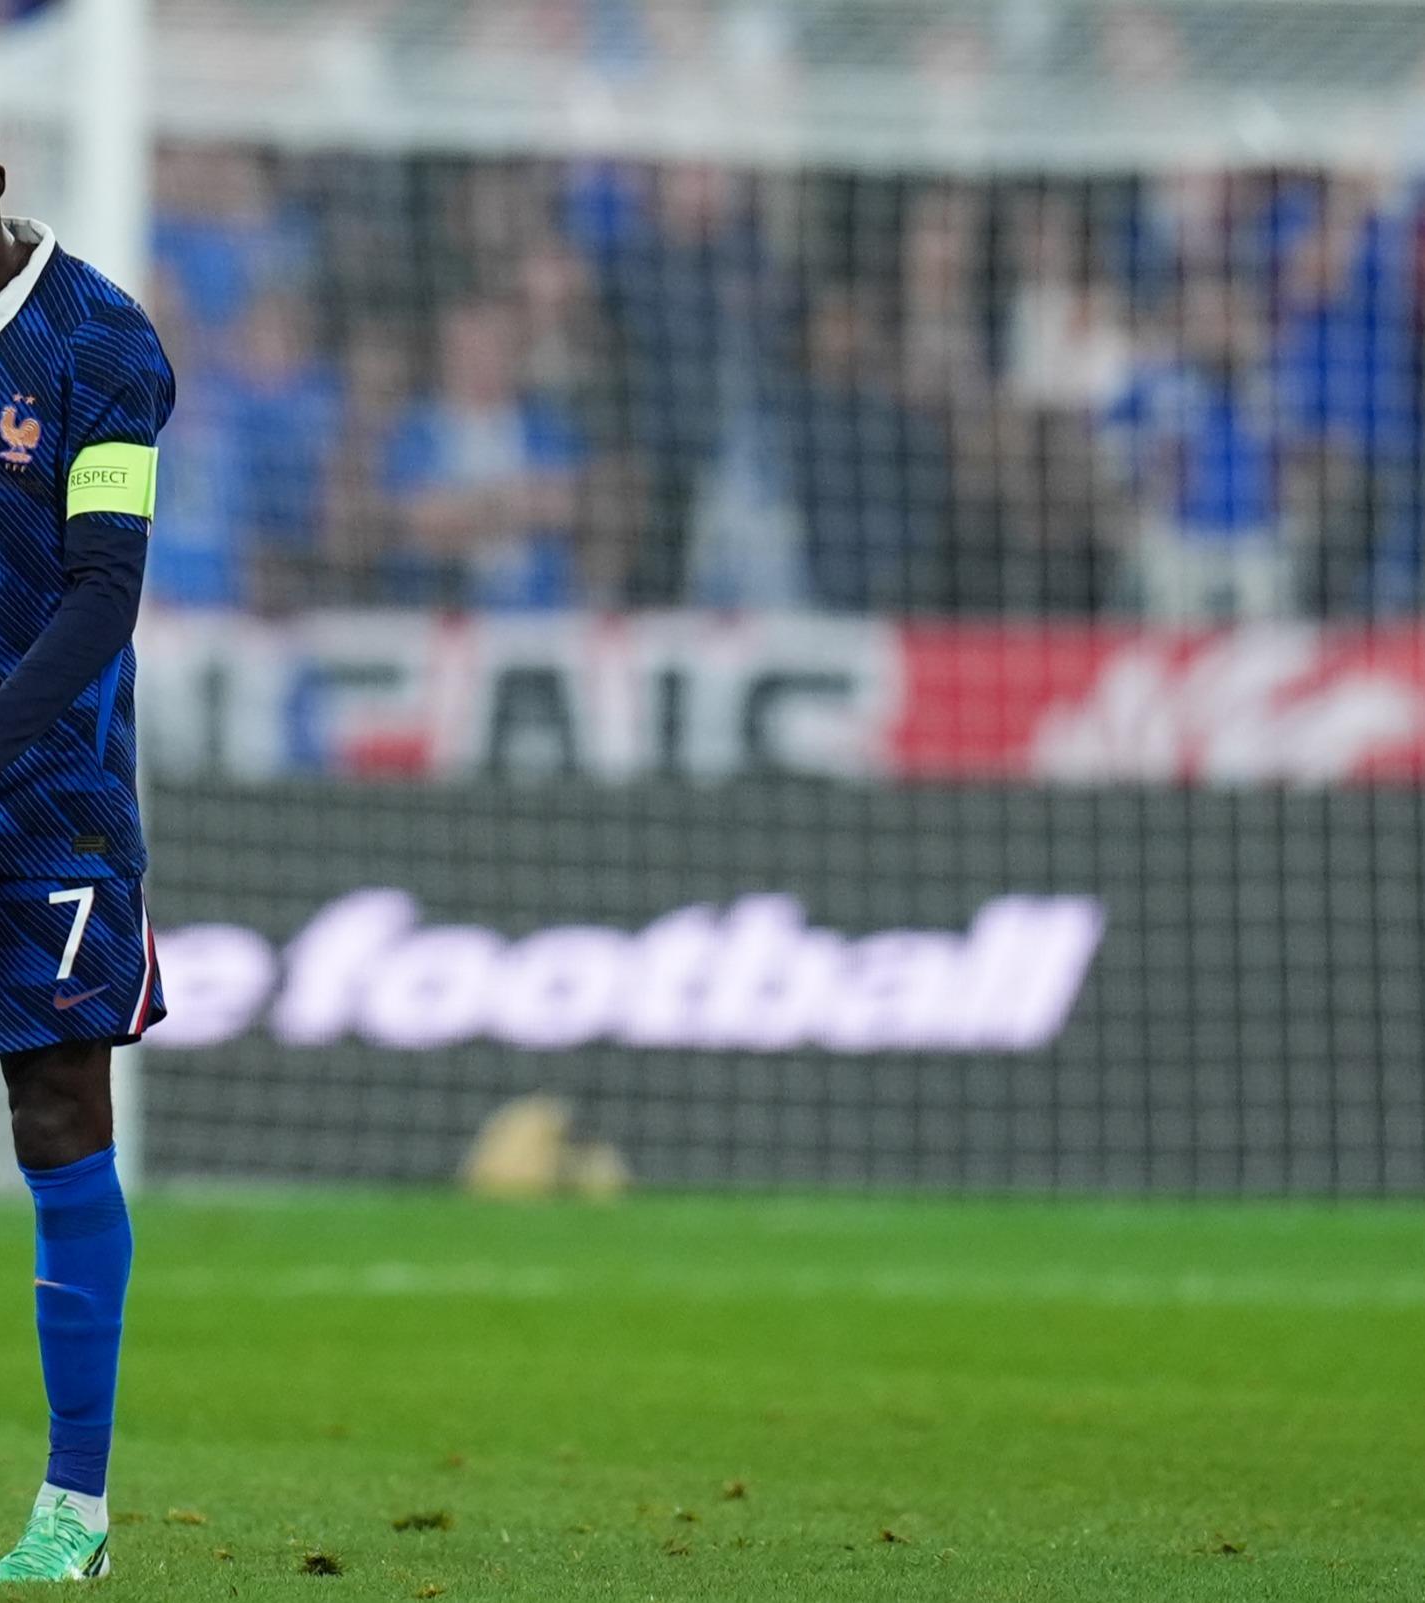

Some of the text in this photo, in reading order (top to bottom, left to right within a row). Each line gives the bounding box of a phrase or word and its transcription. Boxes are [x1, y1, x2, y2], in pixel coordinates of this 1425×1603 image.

[69, 470, 128, 487] RESPECT
[48, 886, 94, 980] 7
[274, 889, 1105, 1049] football
